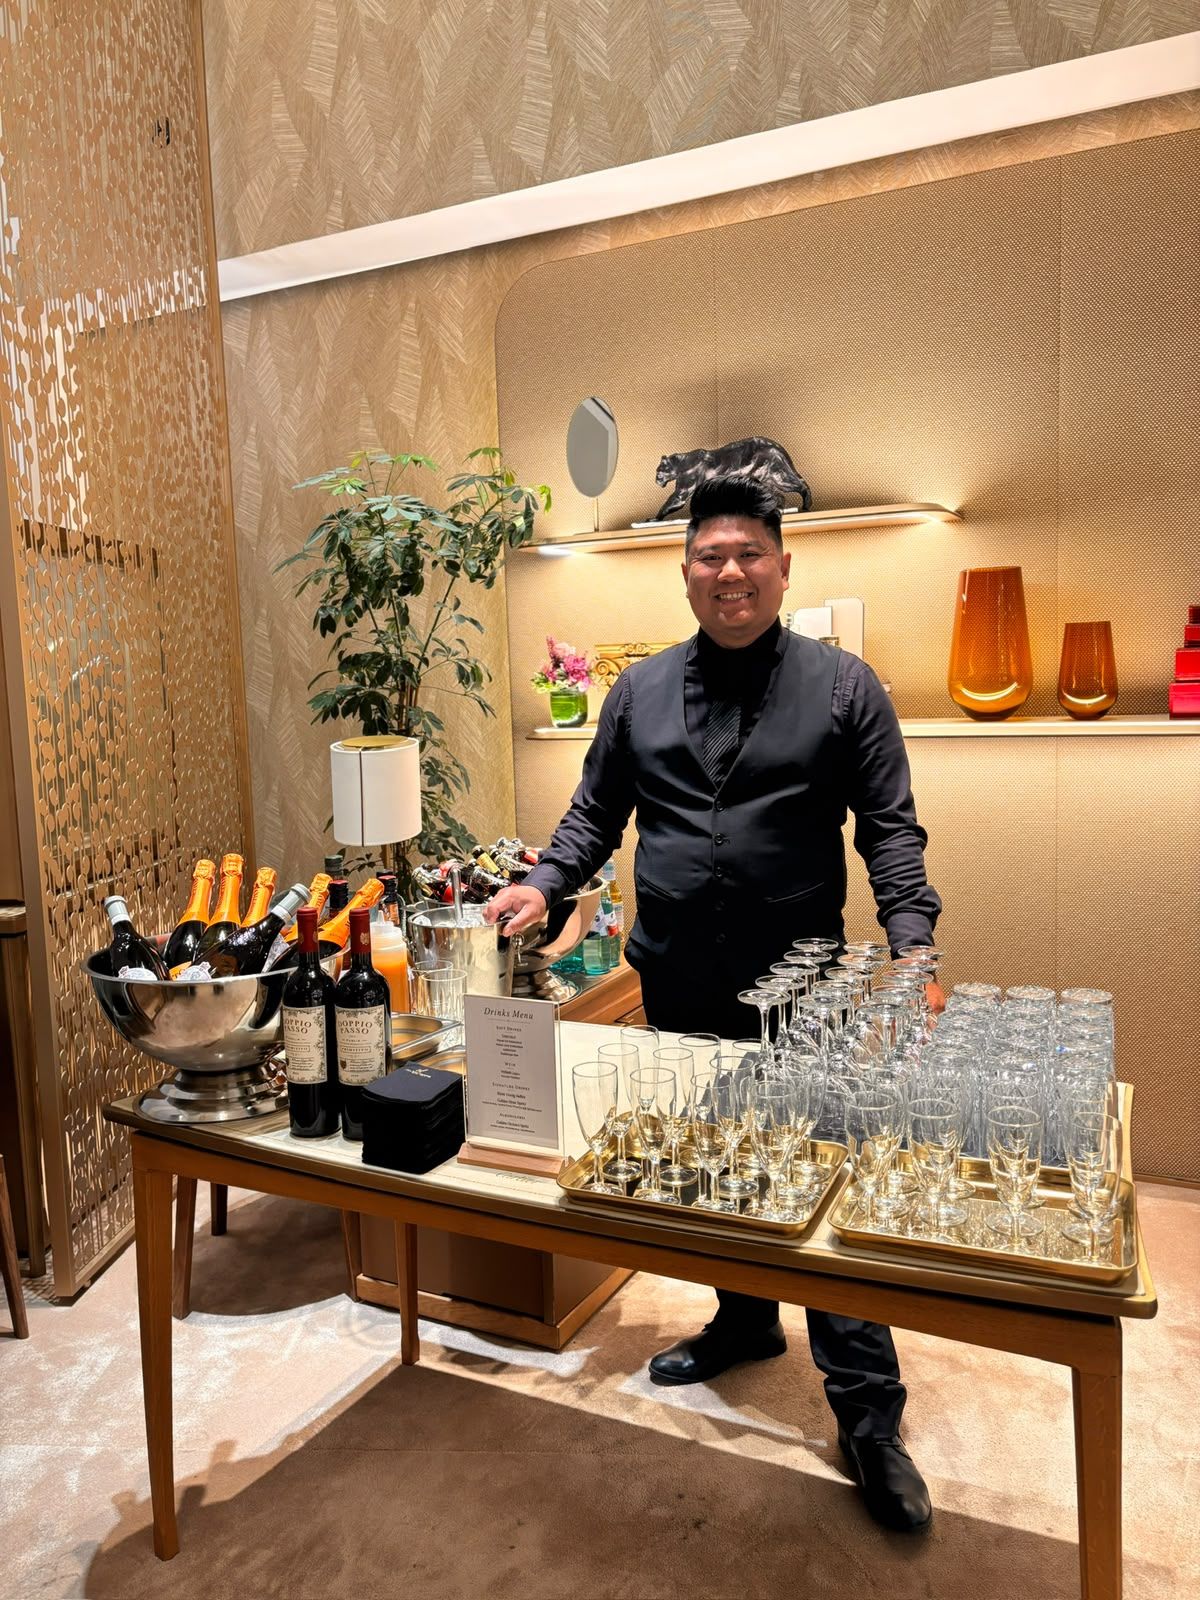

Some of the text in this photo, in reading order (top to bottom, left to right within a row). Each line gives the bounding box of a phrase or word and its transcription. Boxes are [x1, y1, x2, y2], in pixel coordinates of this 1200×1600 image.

[484, 1007, 534, 1020] Drinks Menu
[284, 1019, 312, 1028] OPPIO
